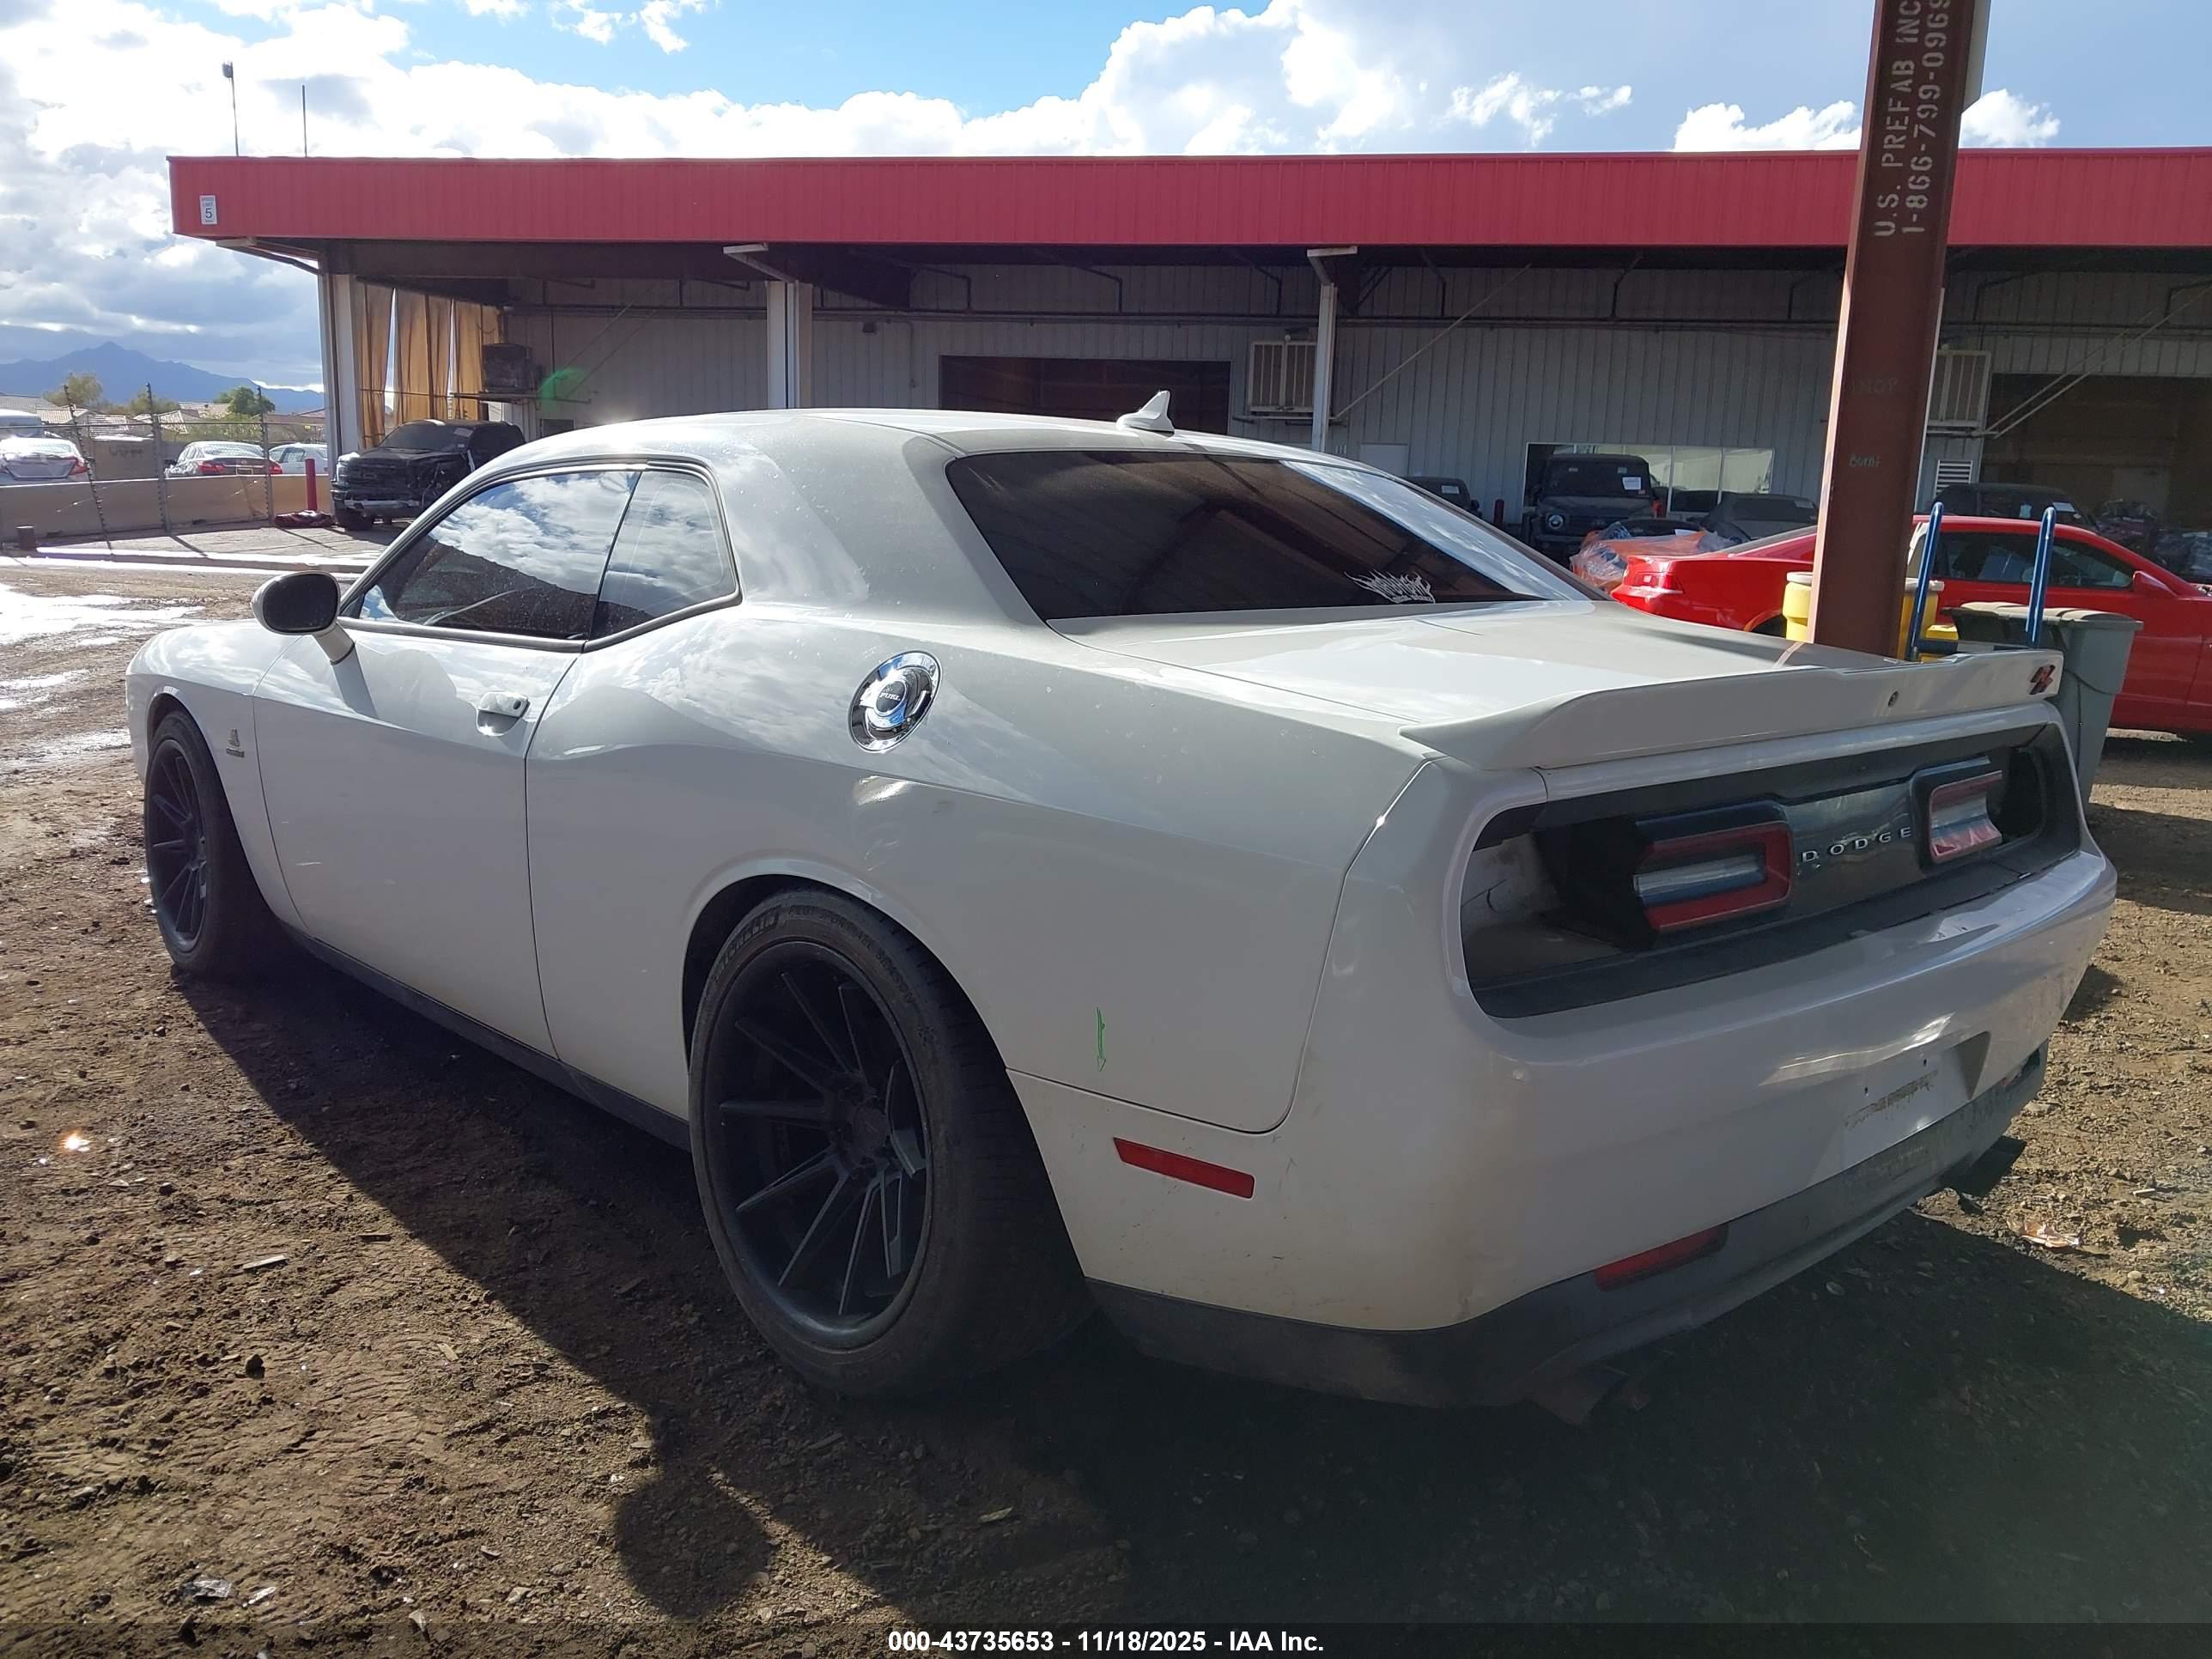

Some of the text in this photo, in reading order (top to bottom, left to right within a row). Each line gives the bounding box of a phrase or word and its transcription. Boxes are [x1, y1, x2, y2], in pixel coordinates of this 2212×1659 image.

[1881, 59, 1915, 167] PREFAB
[205, 208, 213, 219] 5
[1874, 185, 1901, 236] U.S.
[1802, 827, 1911, 862] DODGE
